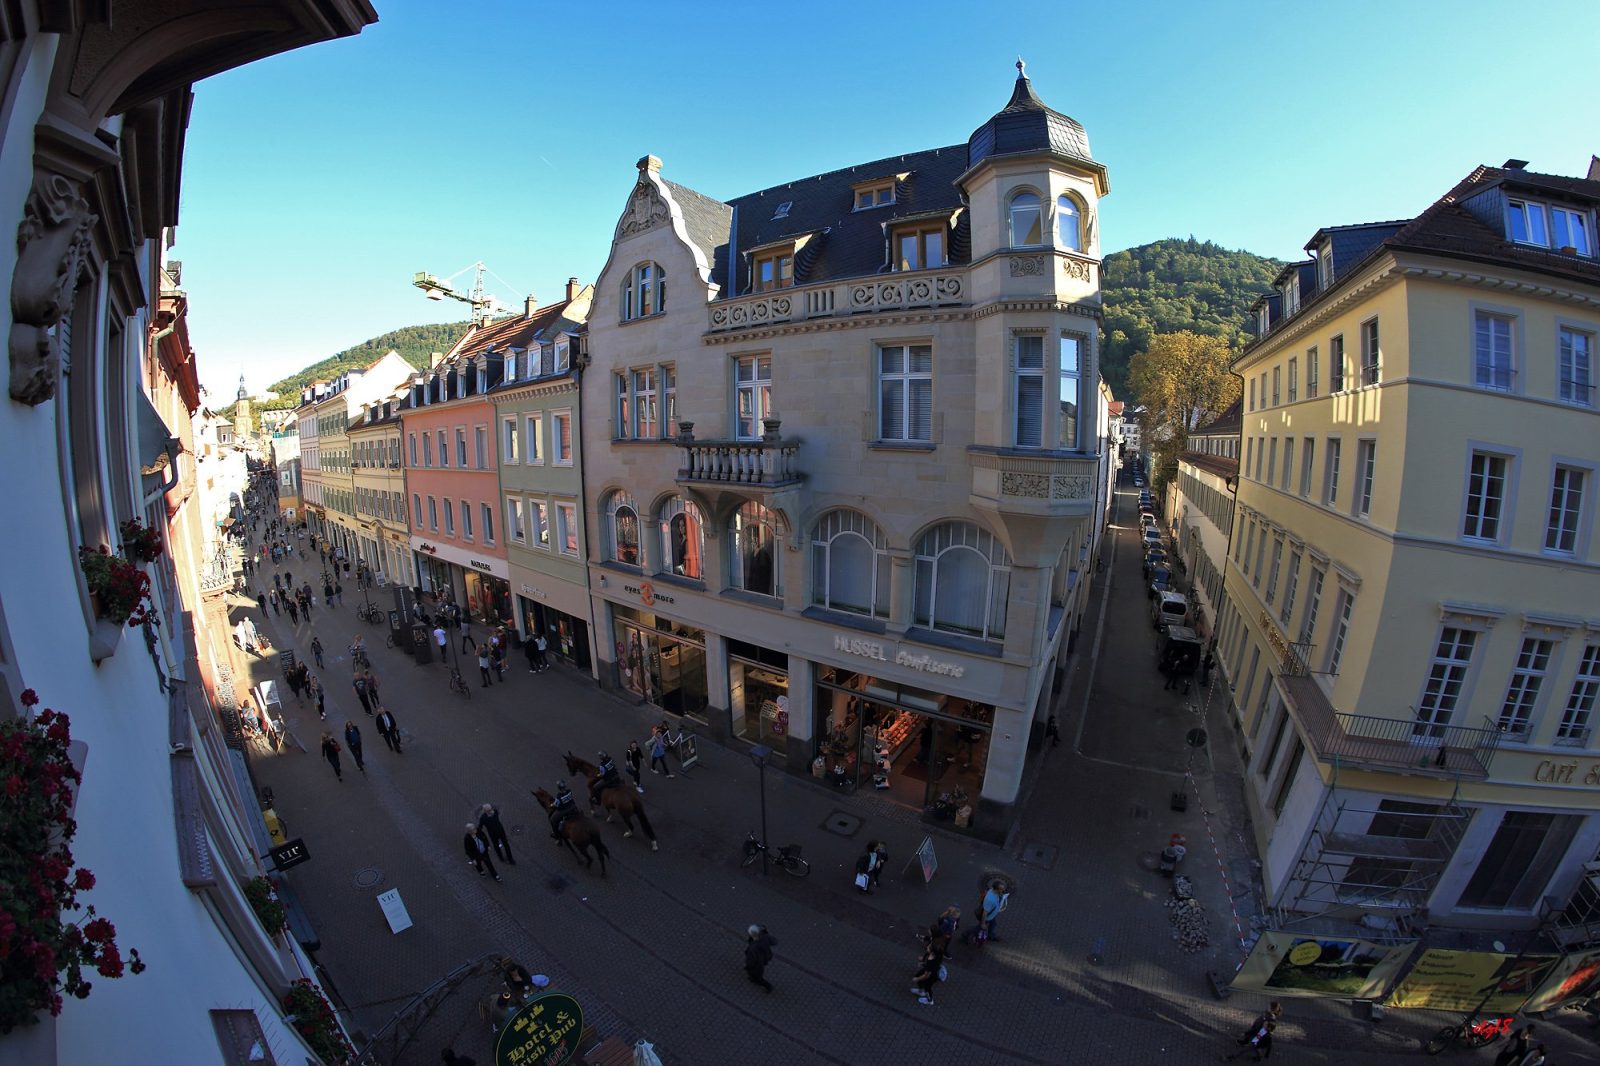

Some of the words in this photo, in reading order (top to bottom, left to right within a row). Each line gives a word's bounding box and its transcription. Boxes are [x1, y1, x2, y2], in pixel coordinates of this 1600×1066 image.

[624, 584, 641, 595] eyes
[653, 593, 674, 604] more
[834, 635, 888, 662] HUSSEL
[896, 651, 964, 678] Confiserie
[507, 1022, 553, 1063] Hotel
[556, 1010, 569, 1024] &
[513, 1044, 546, 1066] rish
[548, 1017, 577, 1046] Pub
